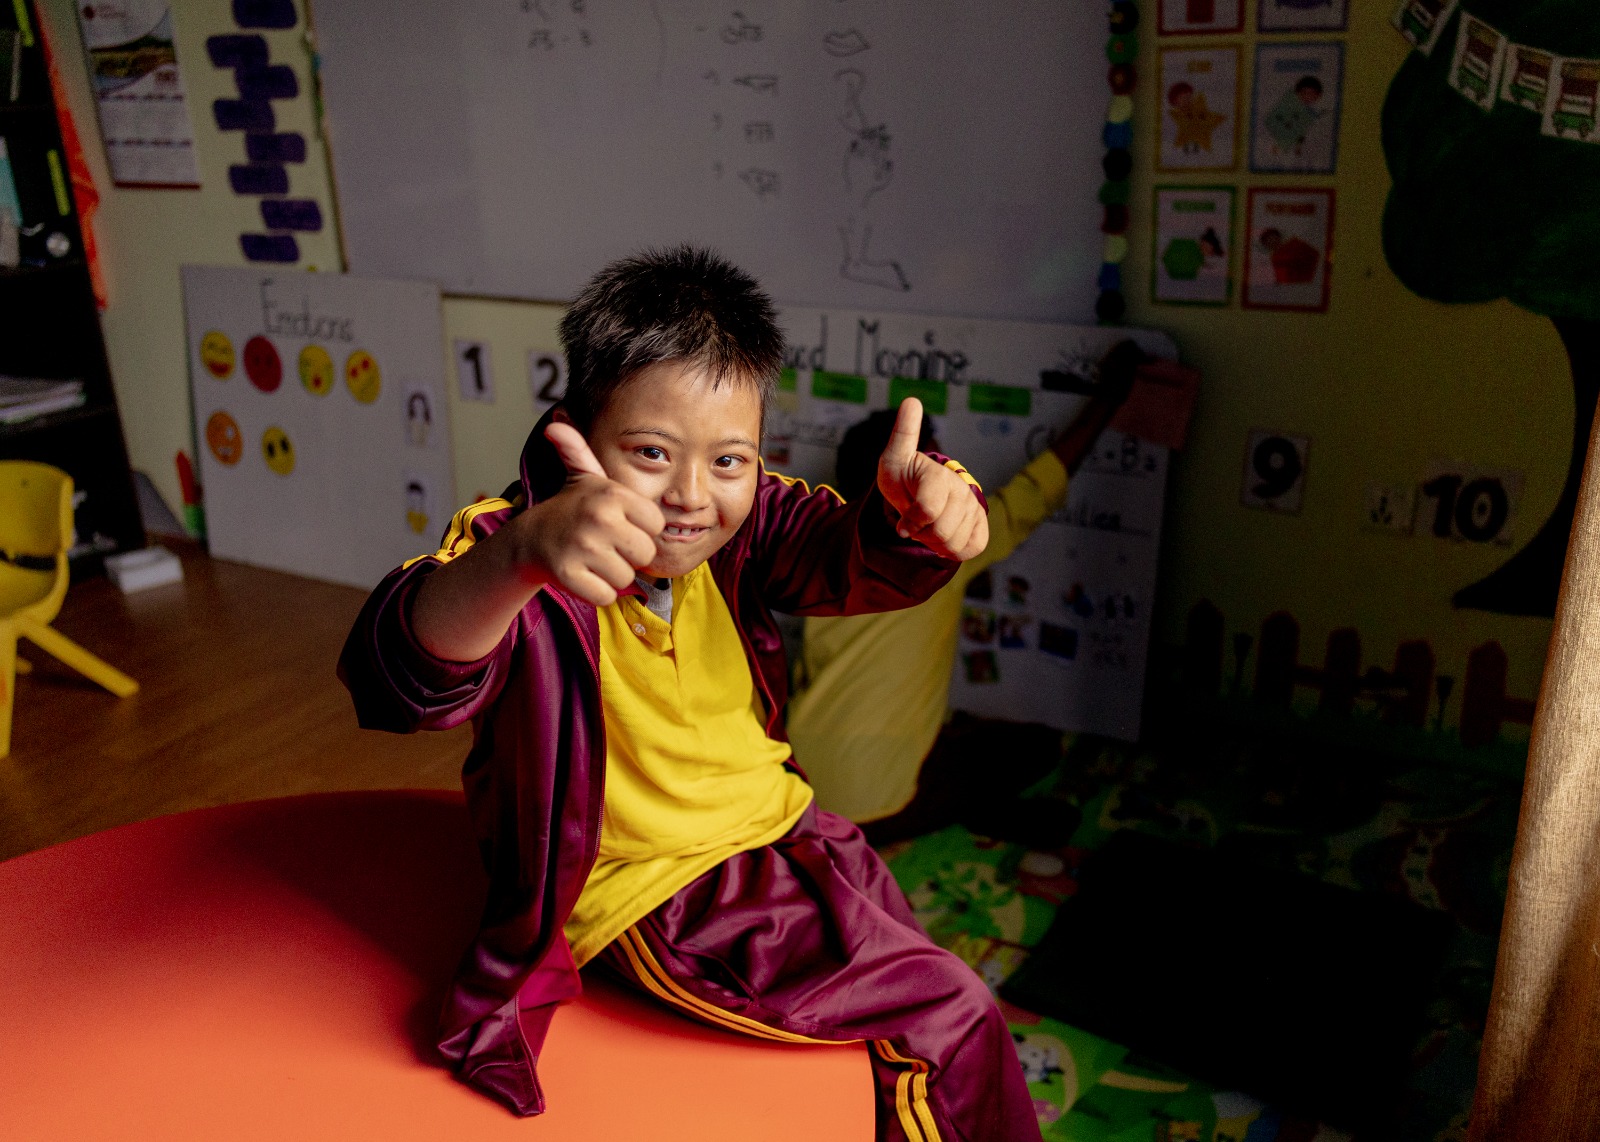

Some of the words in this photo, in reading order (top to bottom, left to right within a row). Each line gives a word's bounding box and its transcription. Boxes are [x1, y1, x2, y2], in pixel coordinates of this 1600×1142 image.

[260, 278, 354, 342] Emotions
[464, 346, 484, 392] 1
[782, 314, 829, 370] ood
[537, 357, 563, 404] 2
[1253, 436, 1302, 499] 9
[1423, 474, 1509, 542] 10
